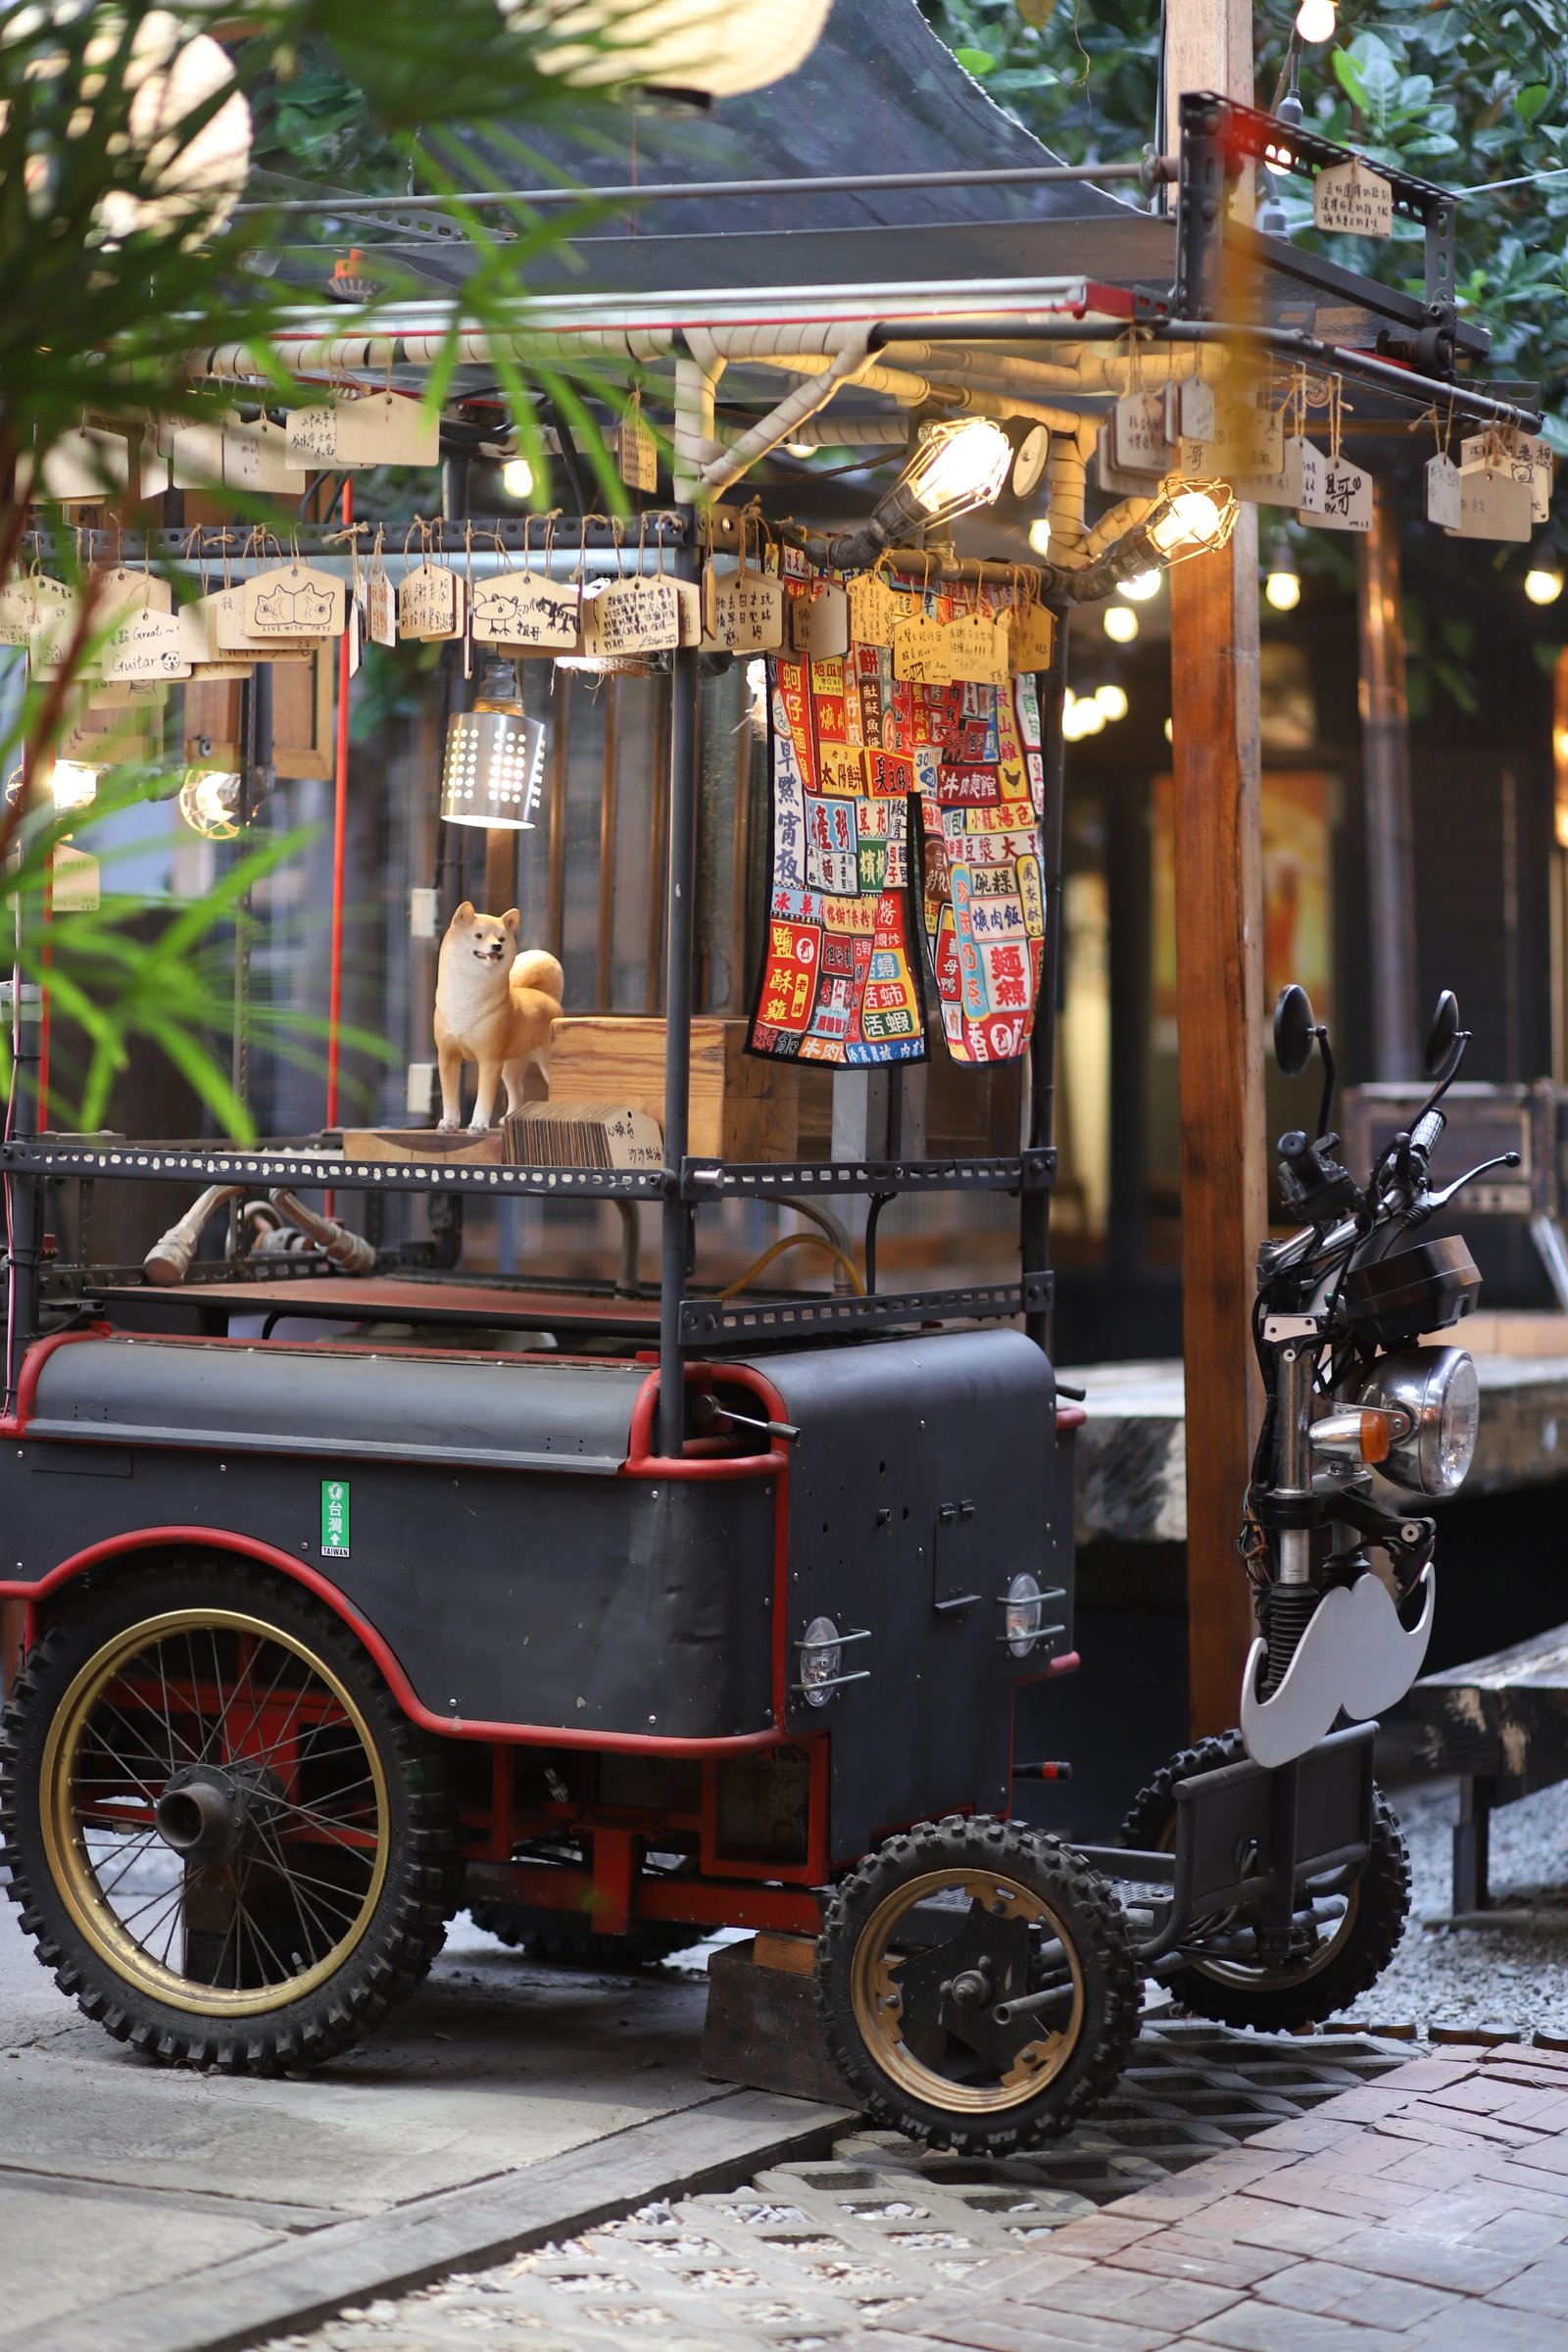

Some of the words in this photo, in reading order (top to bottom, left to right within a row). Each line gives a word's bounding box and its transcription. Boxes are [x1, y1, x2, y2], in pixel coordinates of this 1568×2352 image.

[113, 654, 158, 674] Guitar
[821, 761, 863, 790] 太陽餅
[874, 754, 906, 793] 臭豆腐
[859, 807, 887, 834] 豆花
[974, 868, 1013, 896] 碗粿
[762, 926, 797, 1021] 鹽酥雞
[991, 944, 1027, 1007] 麵線
[864, 1011, 910, 1037] 活蝦
[327, 1500, 343, 1534] 台灣
[322, 1546, 348, 1557] TAIWAN
